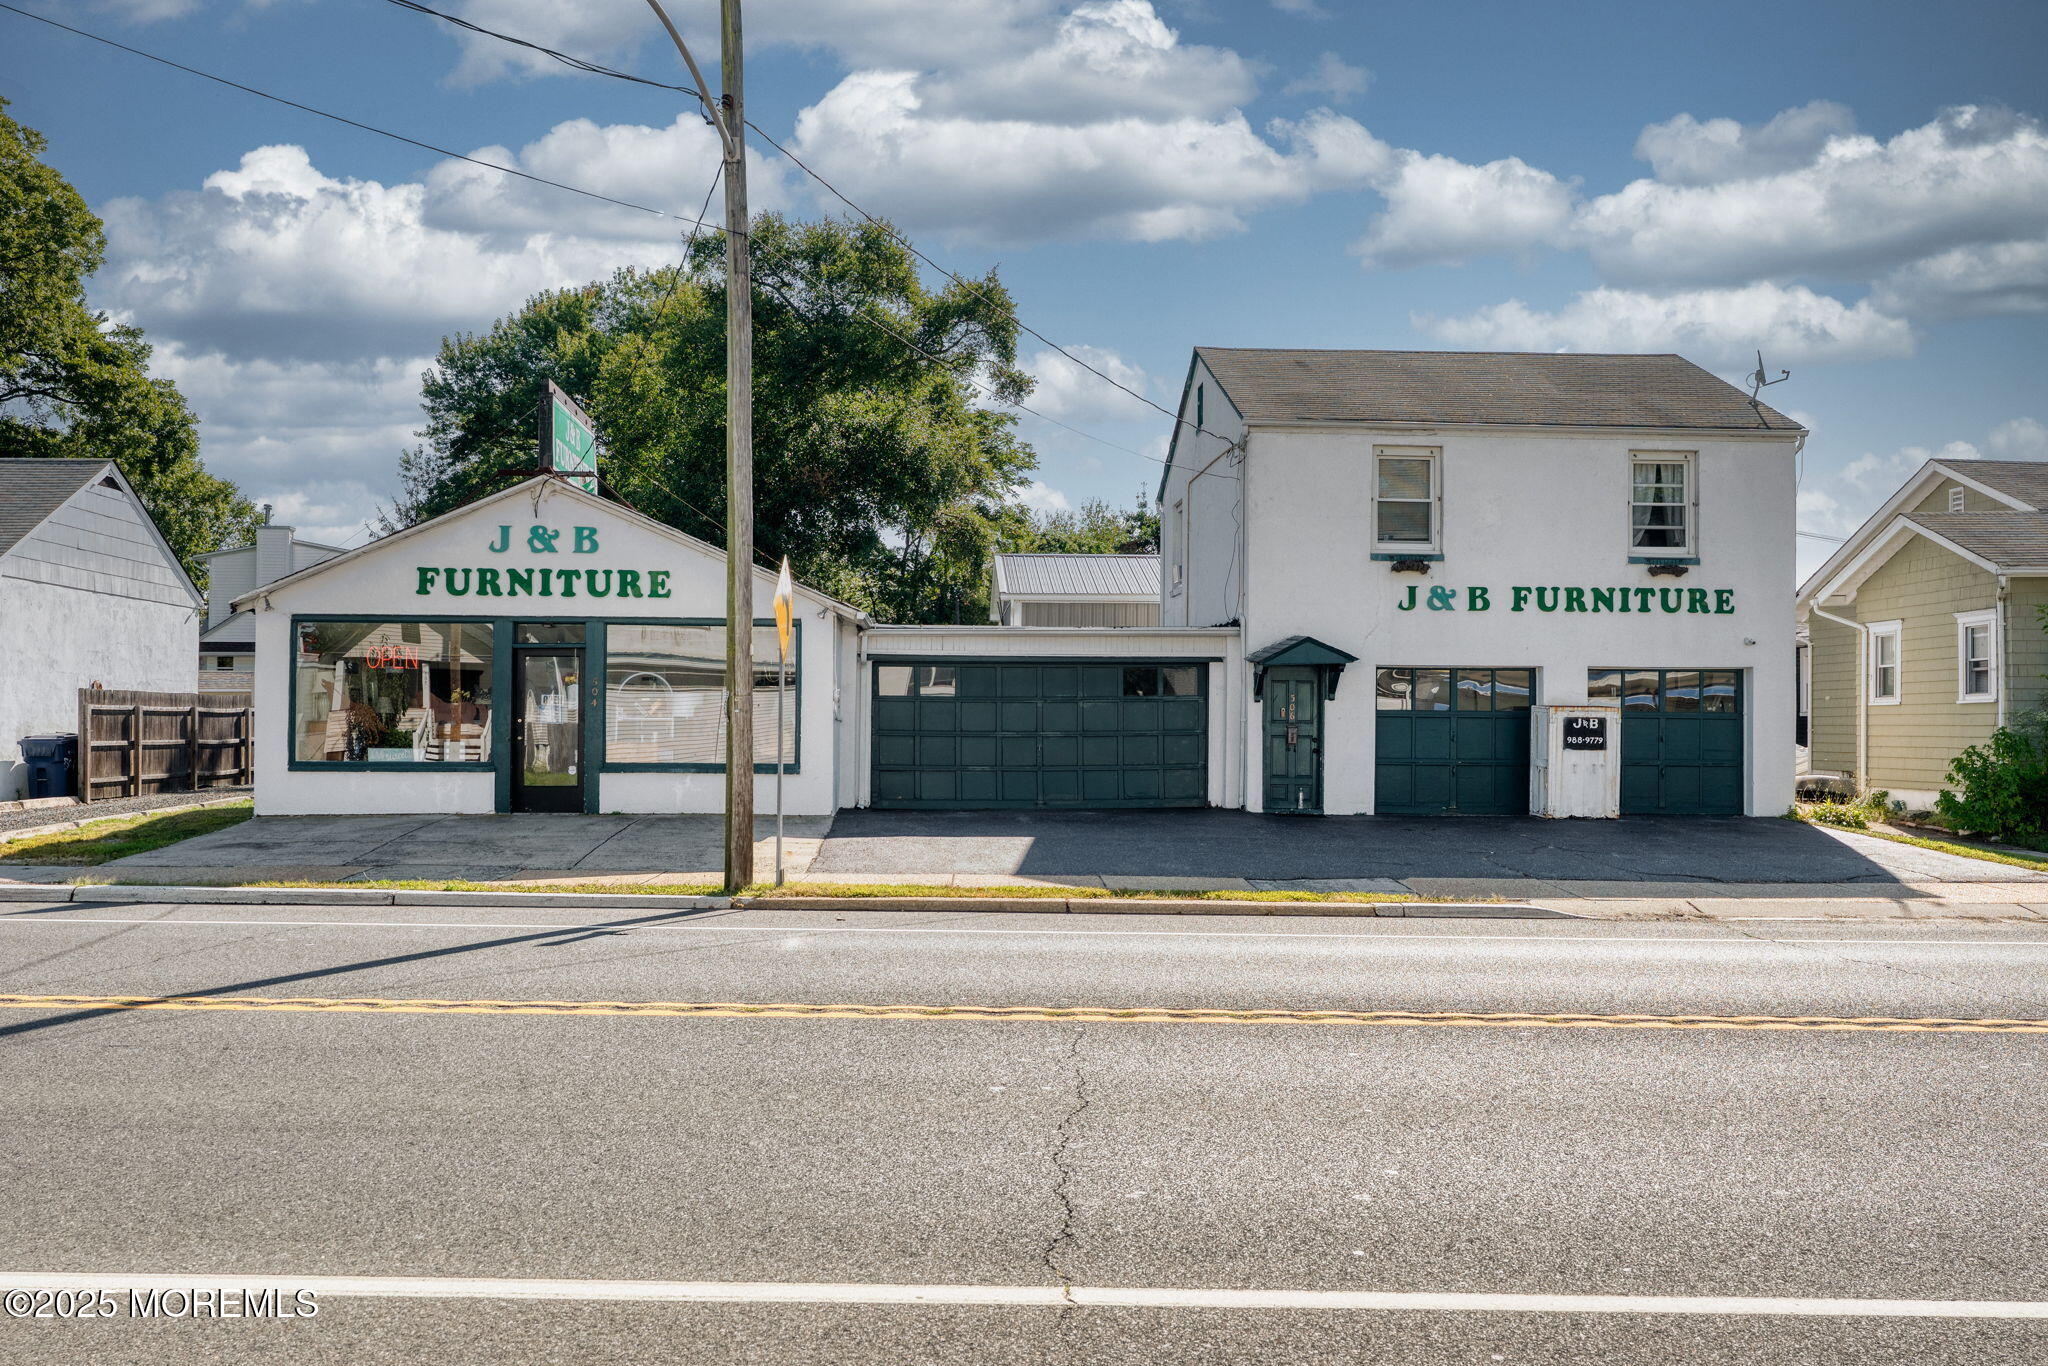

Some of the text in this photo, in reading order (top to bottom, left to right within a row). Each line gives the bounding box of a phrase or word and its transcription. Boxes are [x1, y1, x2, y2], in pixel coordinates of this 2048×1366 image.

[488, 525, 600, 554] J & B
[416, 566, 672, 598] FURNITURE
[1398, 585, 1735, 614] J & B FURNITURE
[366, 646, 418, 669] OPEN
